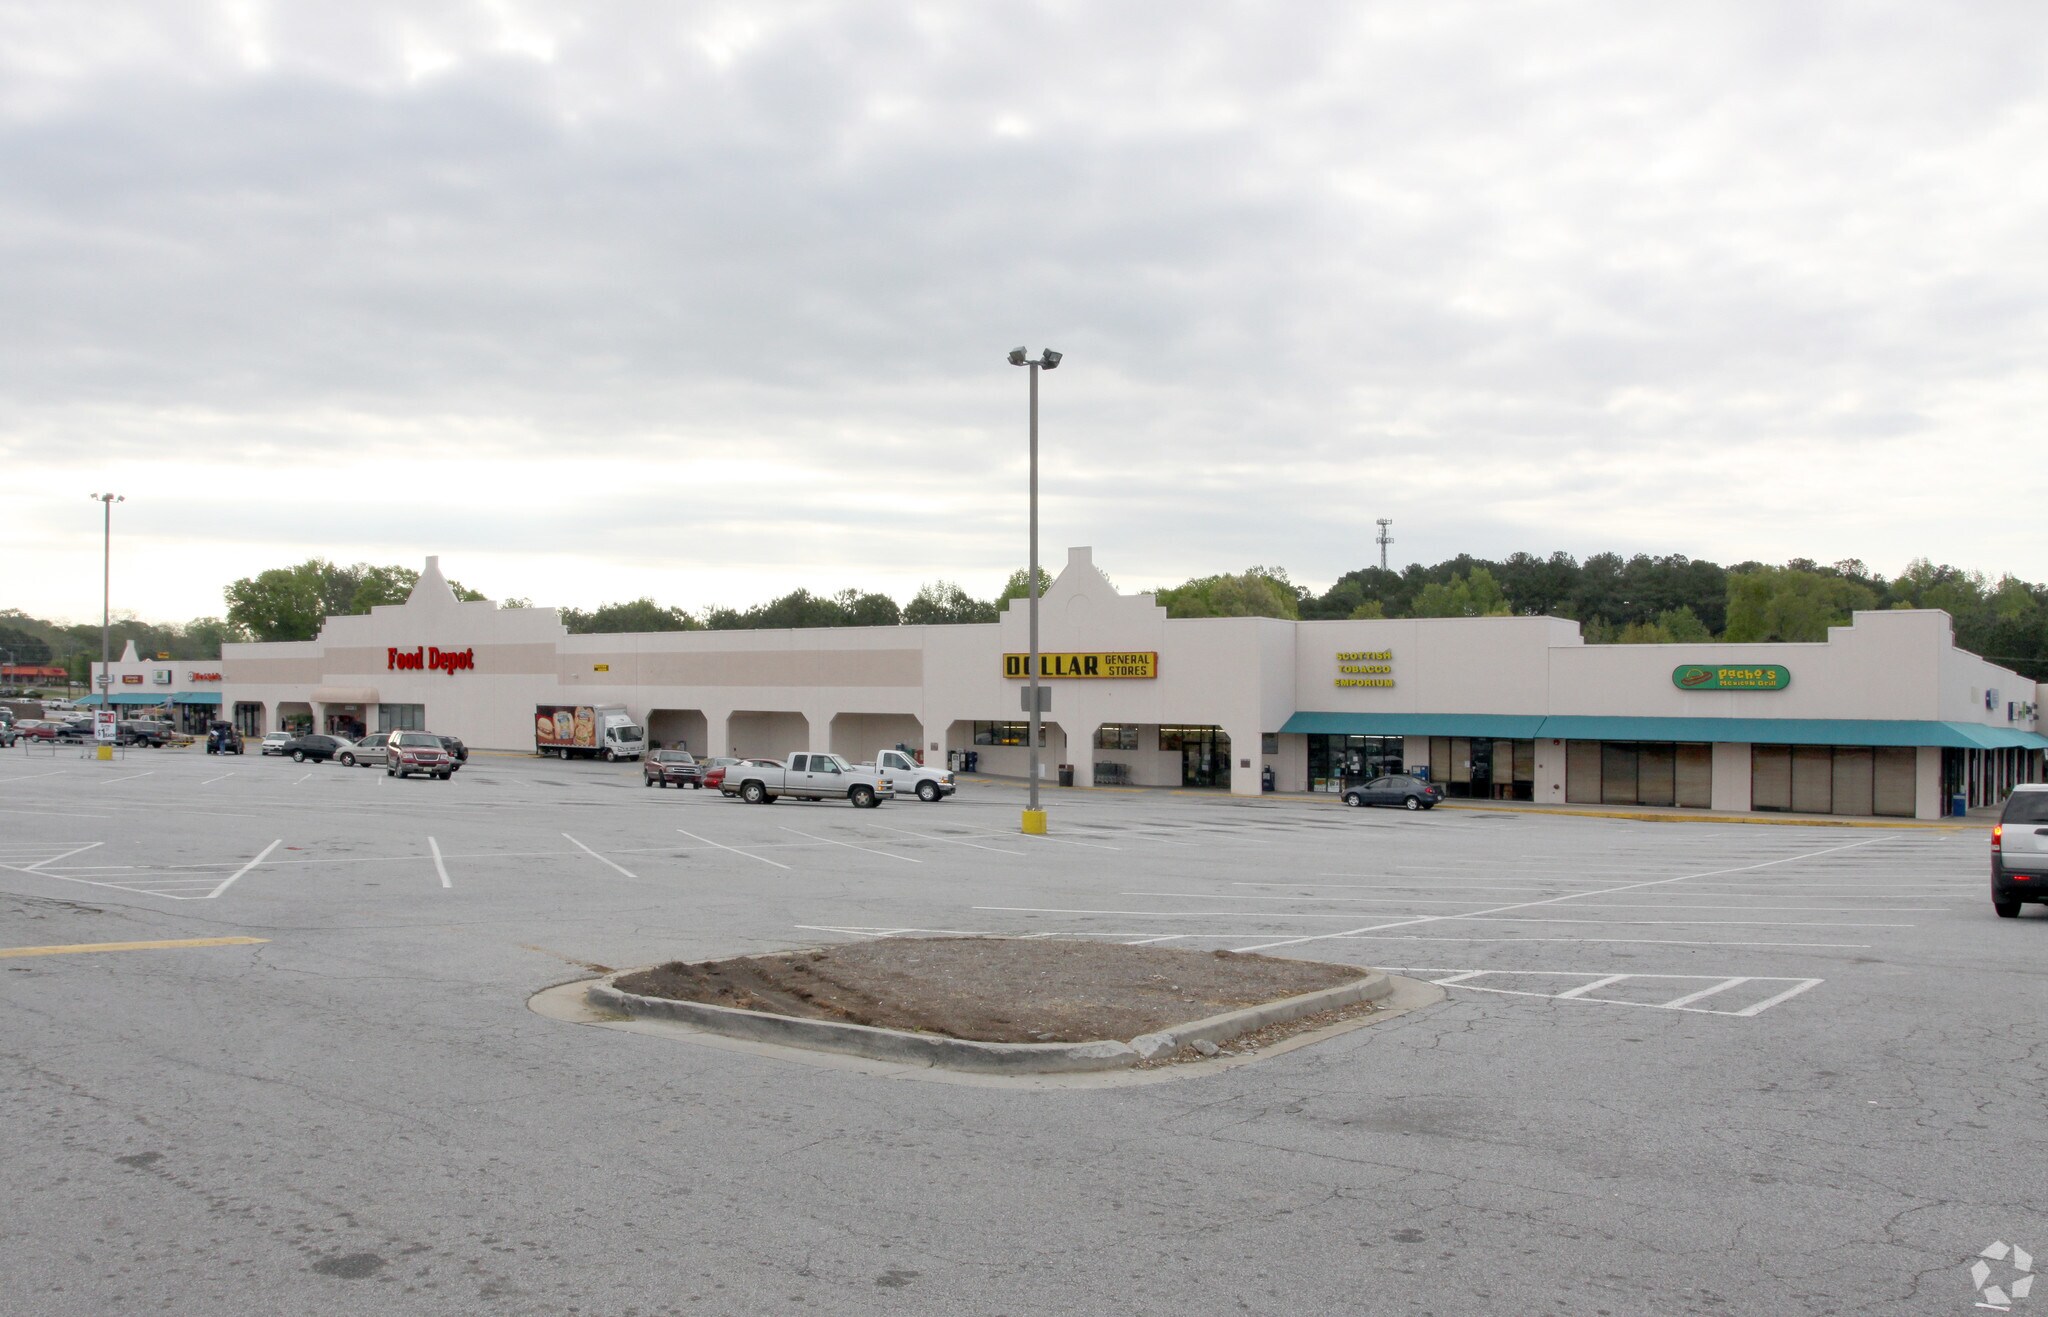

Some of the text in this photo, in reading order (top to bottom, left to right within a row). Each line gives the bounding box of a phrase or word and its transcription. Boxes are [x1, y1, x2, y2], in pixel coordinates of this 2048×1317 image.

[1105, 655, 1150, 664] GENERAL
[1336, 651, 1392, 660] SCOTTISH
[388, 646, 474, 675] Food Depot
[1109, 666, 1147, 676] STORES
[1338, 665, 1391, 673] TOBACCO
[1718, 669, 1776, 680] Pacho's
[1334, 679, 1394, 687] EMPORIUM
